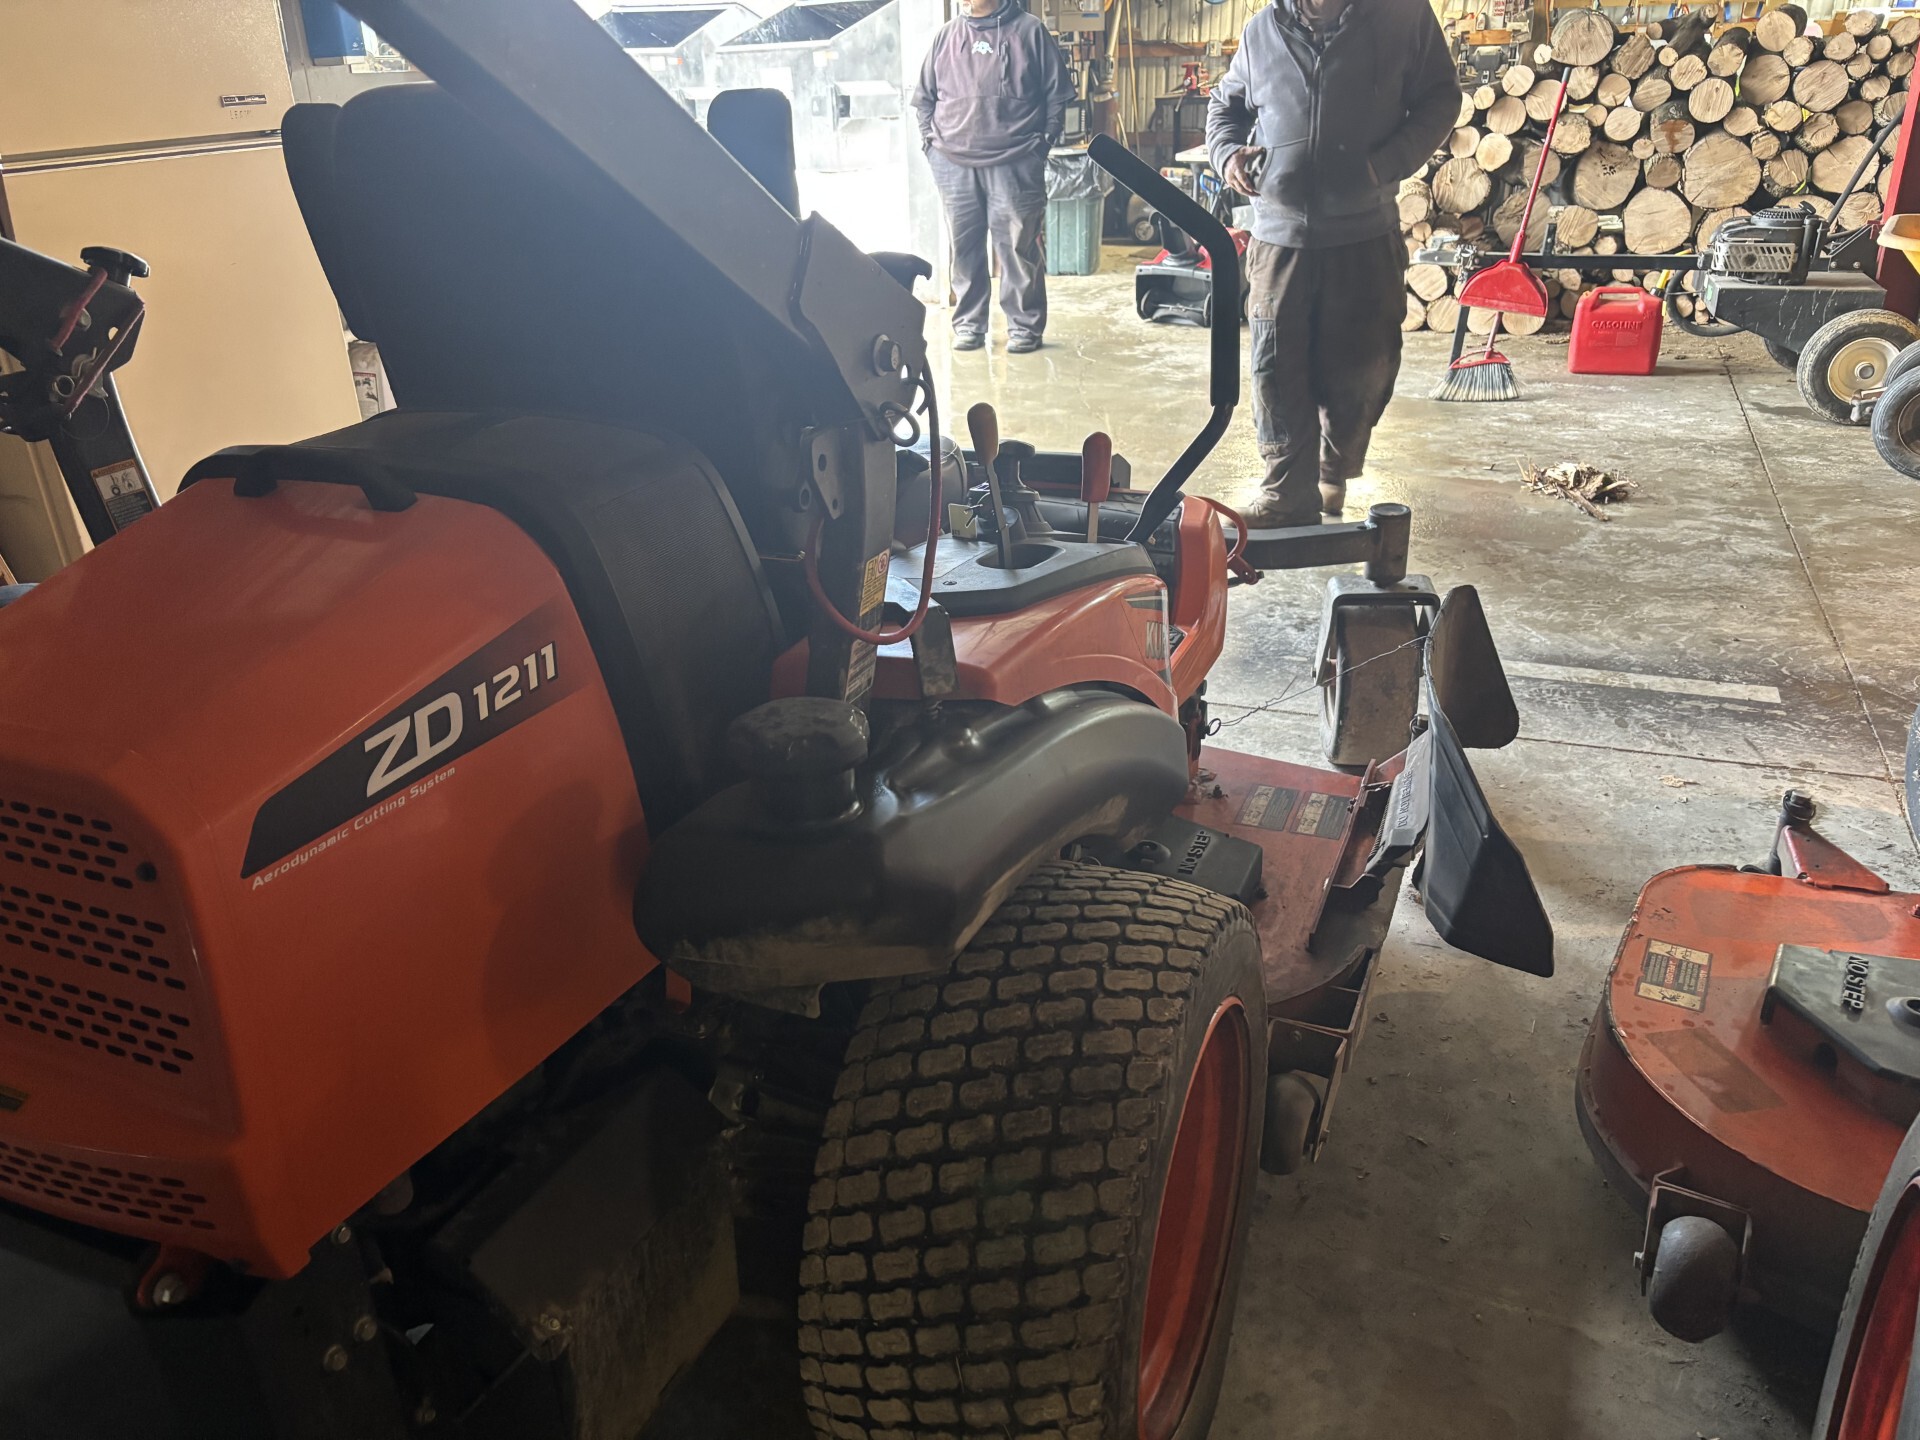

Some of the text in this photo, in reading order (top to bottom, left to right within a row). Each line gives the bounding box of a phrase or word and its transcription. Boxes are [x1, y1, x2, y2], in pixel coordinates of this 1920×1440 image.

[364, 643, 556, 798] ZD 1211
[252, 767, 456, 890] Aerodynamic Cutting System
[1177, 829, 1211, 875] NO STEP
[1841, 954, 1869, 1011] NO STEP
